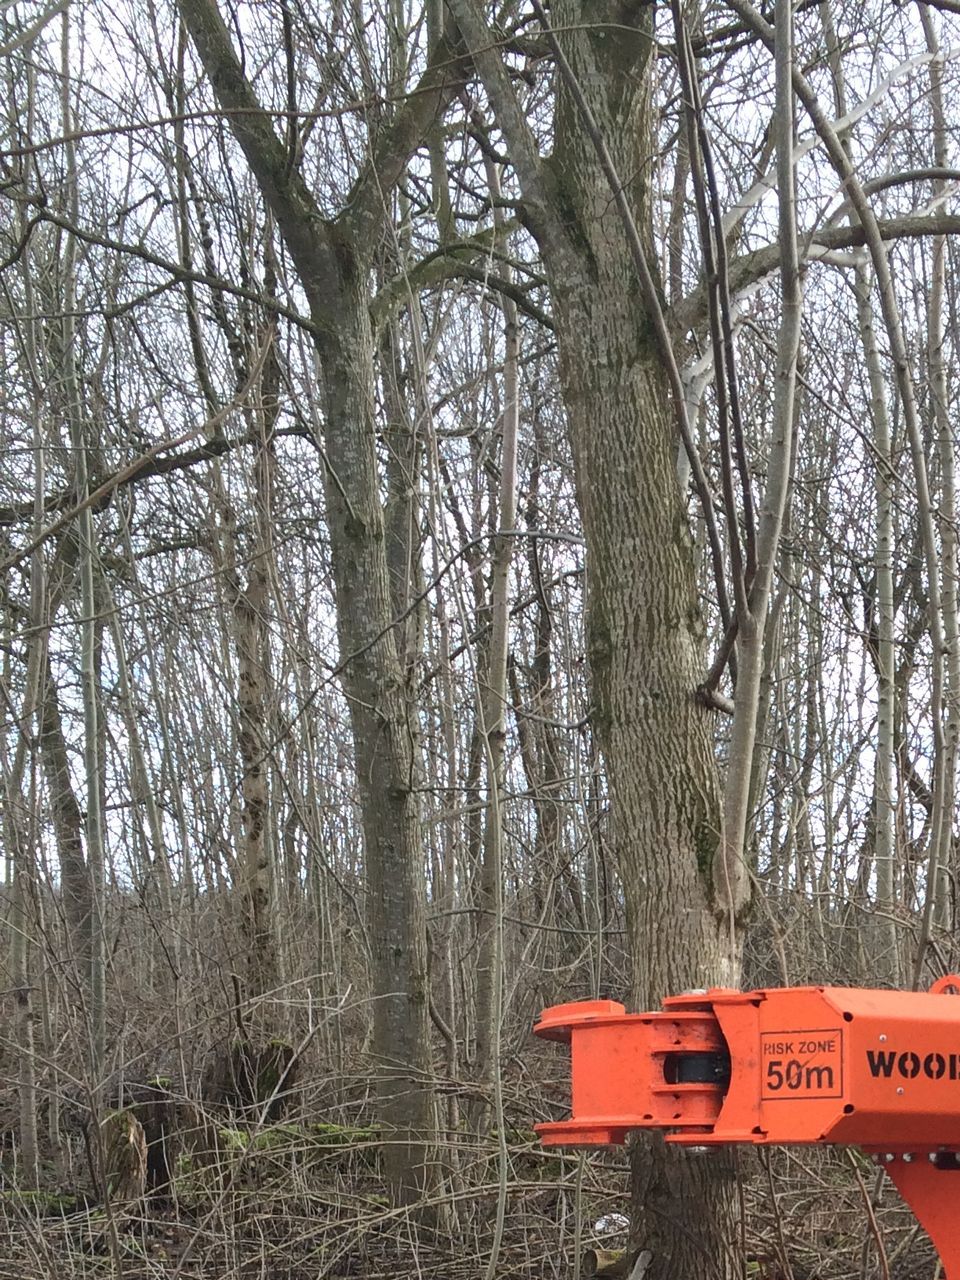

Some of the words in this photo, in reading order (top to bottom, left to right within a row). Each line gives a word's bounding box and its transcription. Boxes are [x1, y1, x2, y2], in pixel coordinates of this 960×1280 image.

[763, 1041, 795, 1056] RISK
[798, 1040, 837, 1055] ZONE
[766, 1059, 835, 1091] 50m
